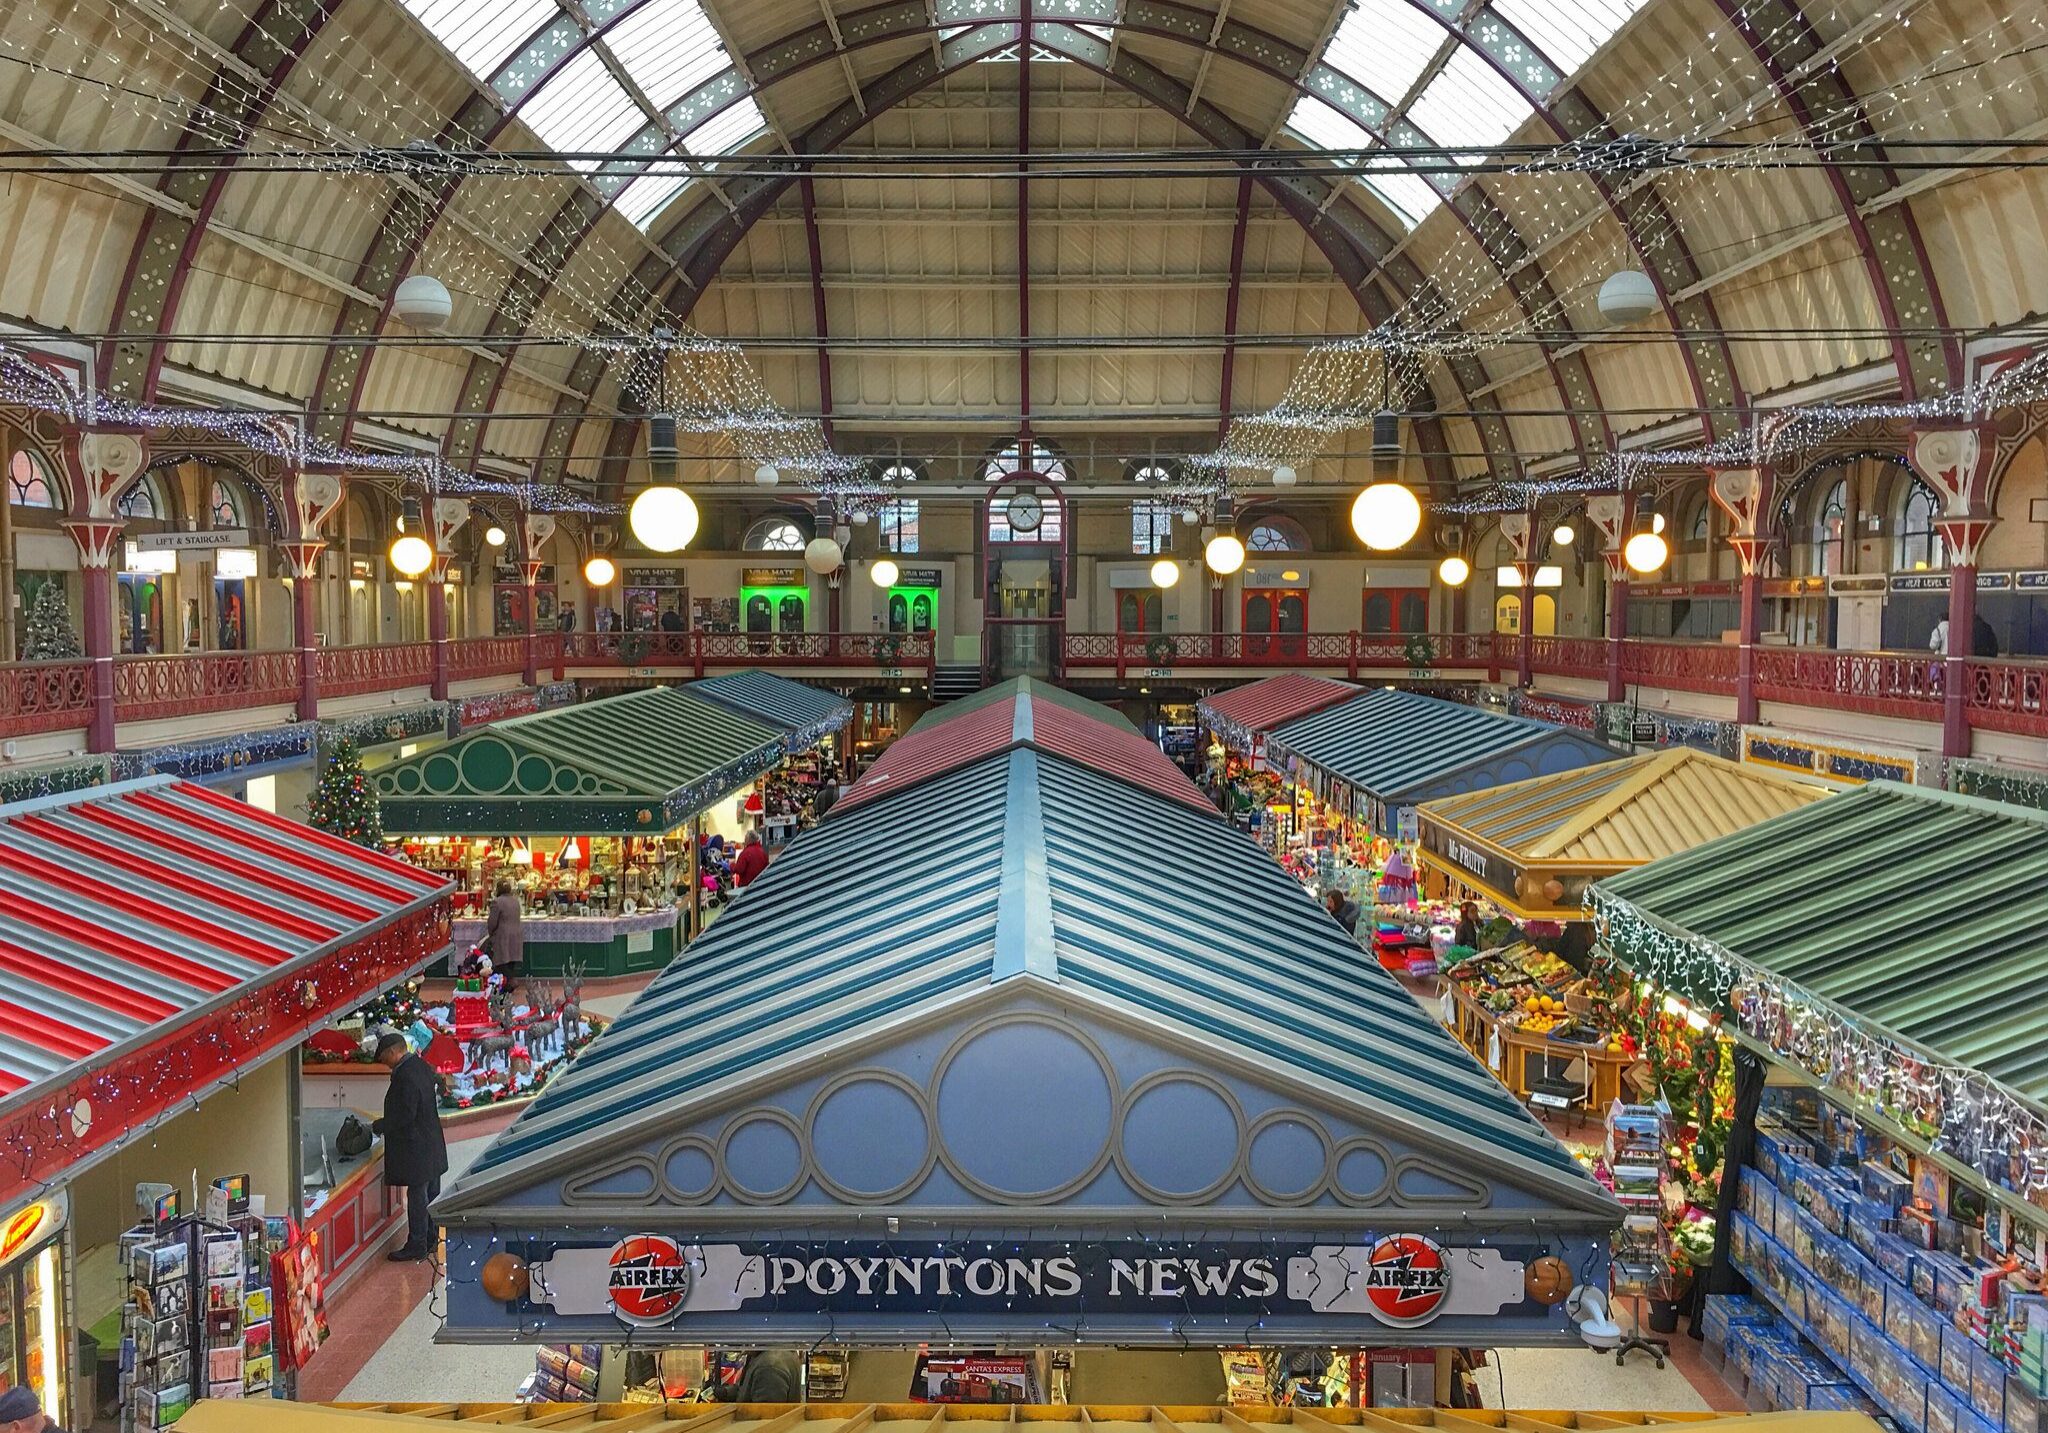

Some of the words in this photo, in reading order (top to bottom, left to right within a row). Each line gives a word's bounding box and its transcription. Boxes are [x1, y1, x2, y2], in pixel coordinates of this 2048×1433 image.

[155, 537, 174, 546] LIFT
[176, 537, 183, 545] &
[185, 535, 231, 545] STAIRCASE
[1448, 838, 1458, 860] Mr
[1459, 844, 1487, 877] FRUITY
[608, 1268, 686, 1286] AIRFIX
[770, 1257, 1083, 1298] POYNTONS
[1108, 1257, 1279, 1299] NEWS
[1366, 1269, 1445, 1287] AIRFIX
[1368, 1352, 1401, 1363] January
[965, 1365, 992, 1373] SANTA'S
[993, 1365, 1022, 1373] EXPRESS
